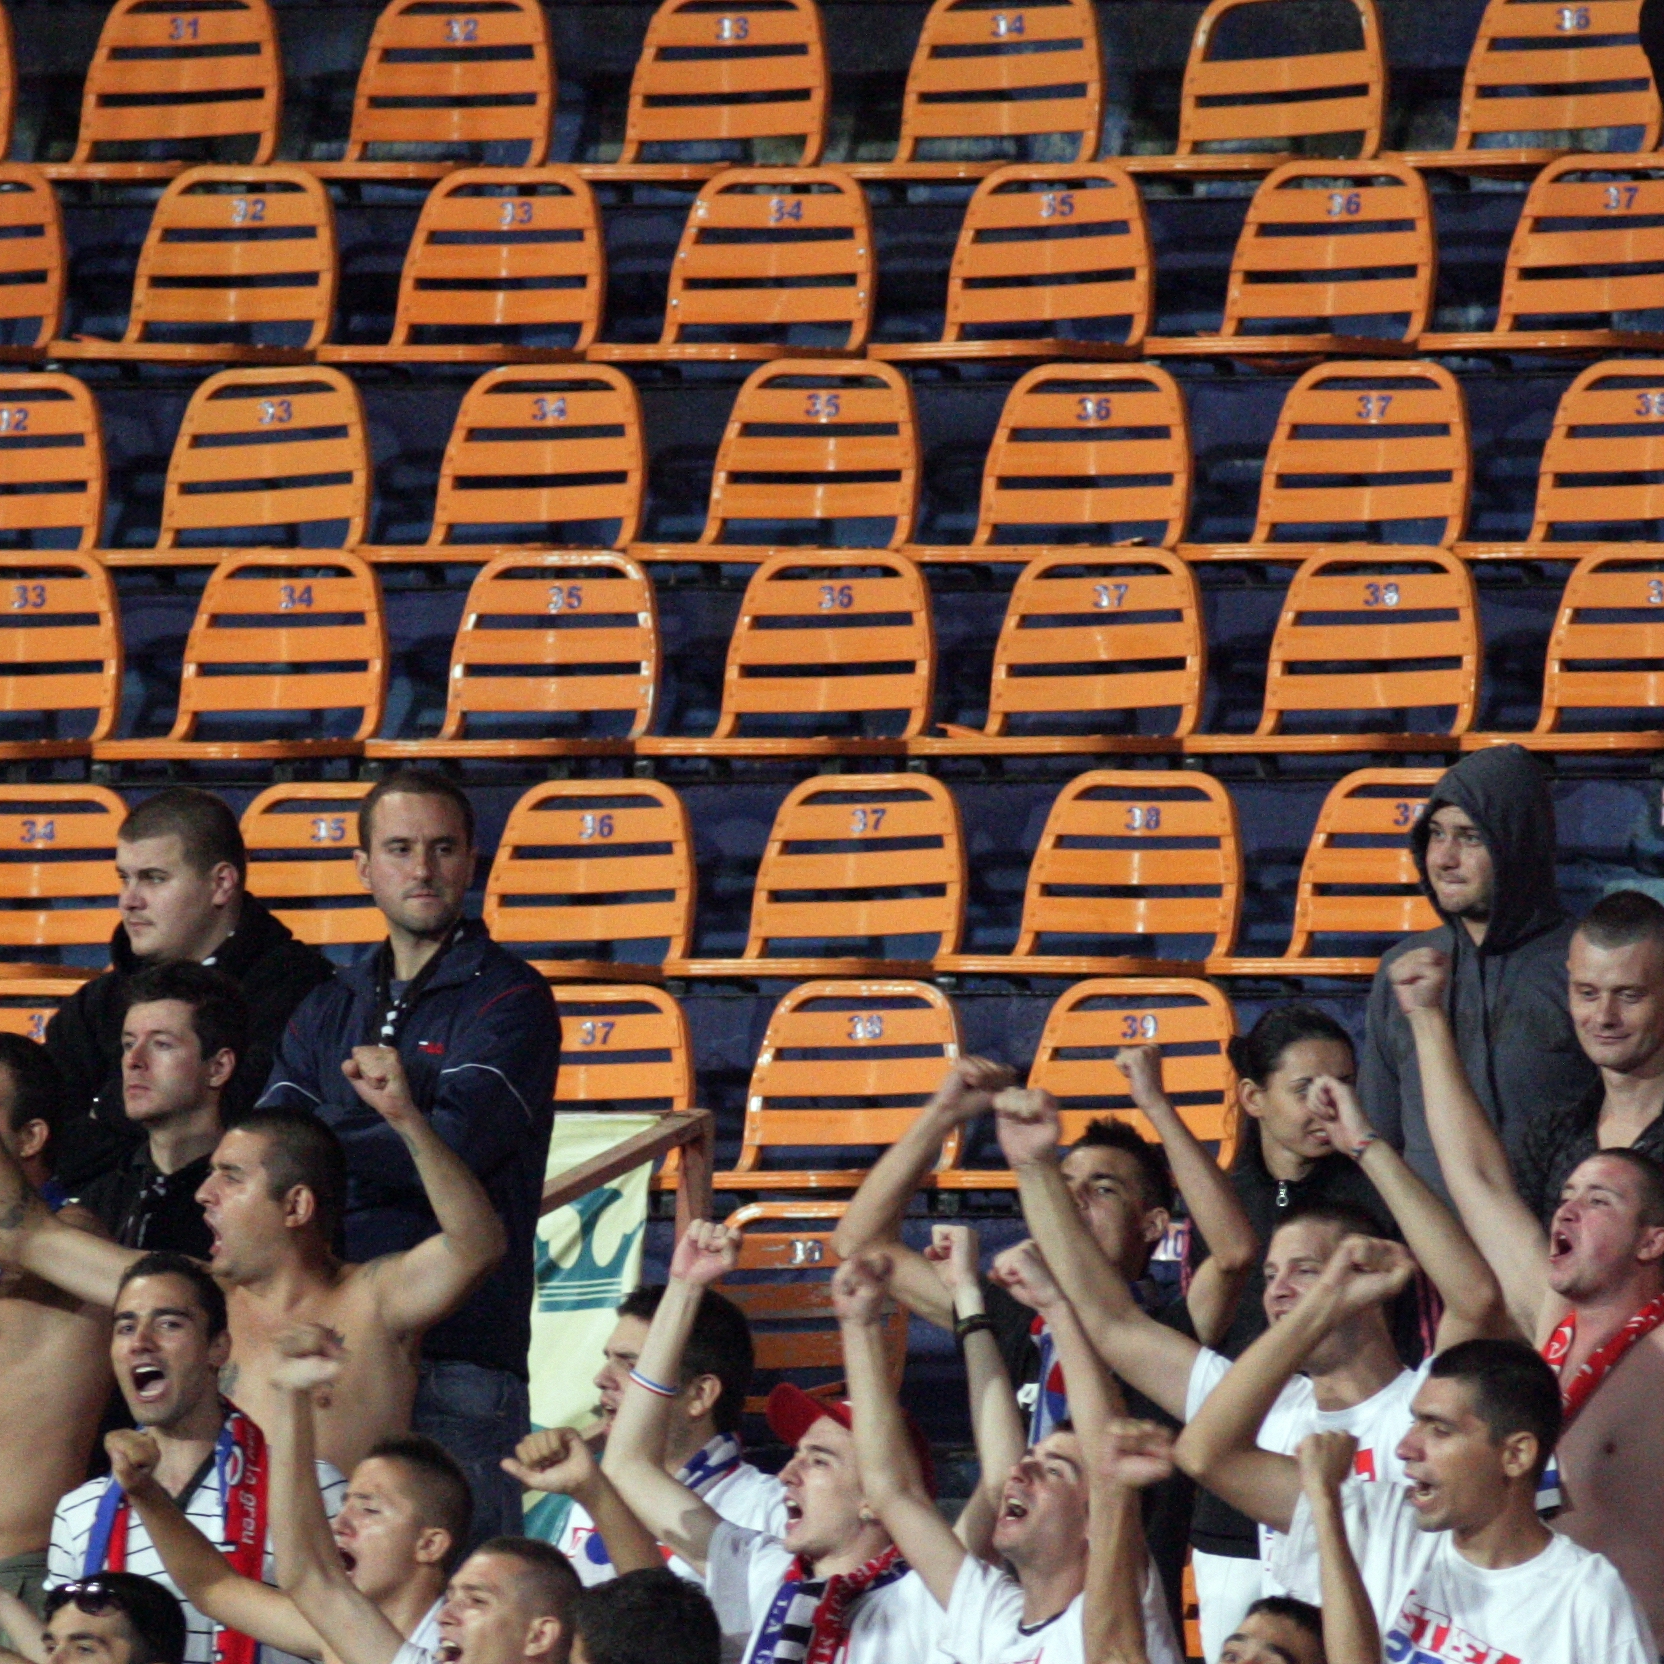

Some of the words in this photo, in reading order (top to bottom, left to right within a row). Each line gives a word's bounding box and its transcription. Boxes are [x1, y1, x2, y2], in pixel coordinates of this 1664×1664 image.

[171, 19, 198, 39] 31
[445, 19, 477, 42] 32
[1327, 193, 1360, 217] 36
[1605, 187, 1638, 210] 37
[231, 199, 265, 223] 32
[499, 202, 532, 225] 33
[769, 199, 802, 223] 34
[806, 394, 839, 417] 35
[1357, 395, 1392, 419] 37
[12, 585, 45, 609] 33
[279, 586, 313, 610] 34
[547, 586, 581, 612] 35
[819, 586, 852, 610] 36
[579, 814, 613, 839] 36
[850, 809, 885, 834] 37
[1126, 807, 1160, 831] 38
[21, 821, 55, 843] 34
[579, 1021, 614, 1046] 37
[1122, 1015, 1158, 1039] 39
